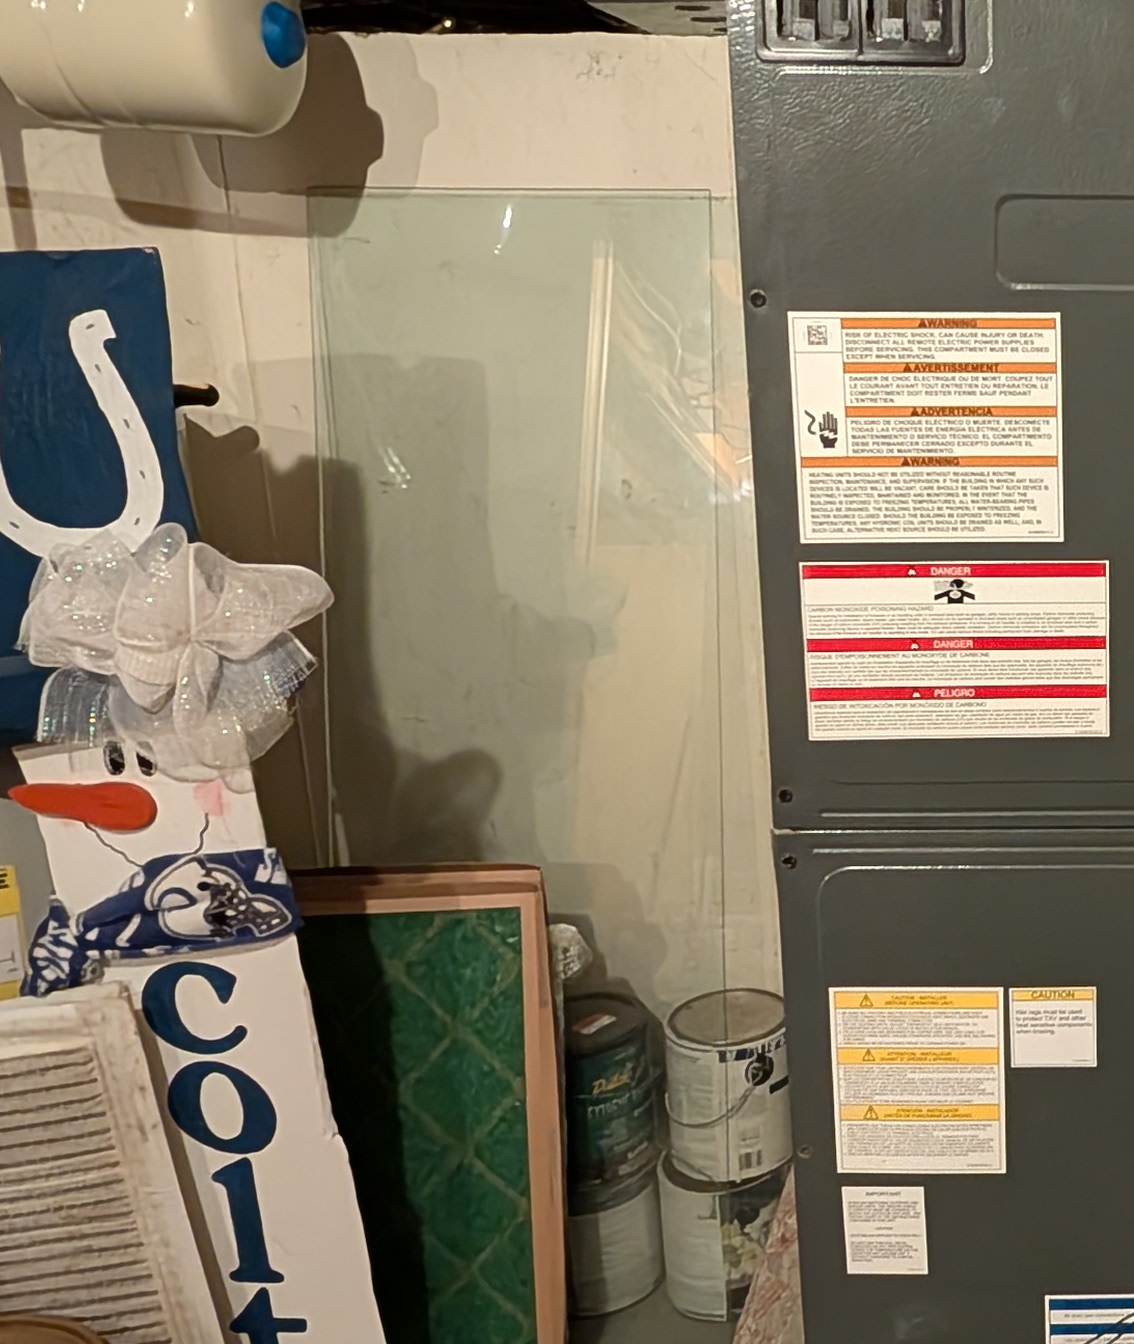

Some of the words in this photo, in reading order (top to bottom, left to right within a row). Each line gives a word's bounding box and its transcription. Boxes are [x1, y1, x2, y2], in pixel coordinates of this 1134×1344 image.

[927, 318, 977, 328] WARNING
[911, 363, 1000, 372] AVERTISSEMENT
[920, 407, 993, 416] ADVERTENCIA
[910, 456, 960, 466] WARNING
[930, 566, 972, 575] DANGER
[932, 639, 974, 648] DANGER
[933, 688, 976, 697] PELIGRO
[1031, 990, 1075, 999] CAUTION
